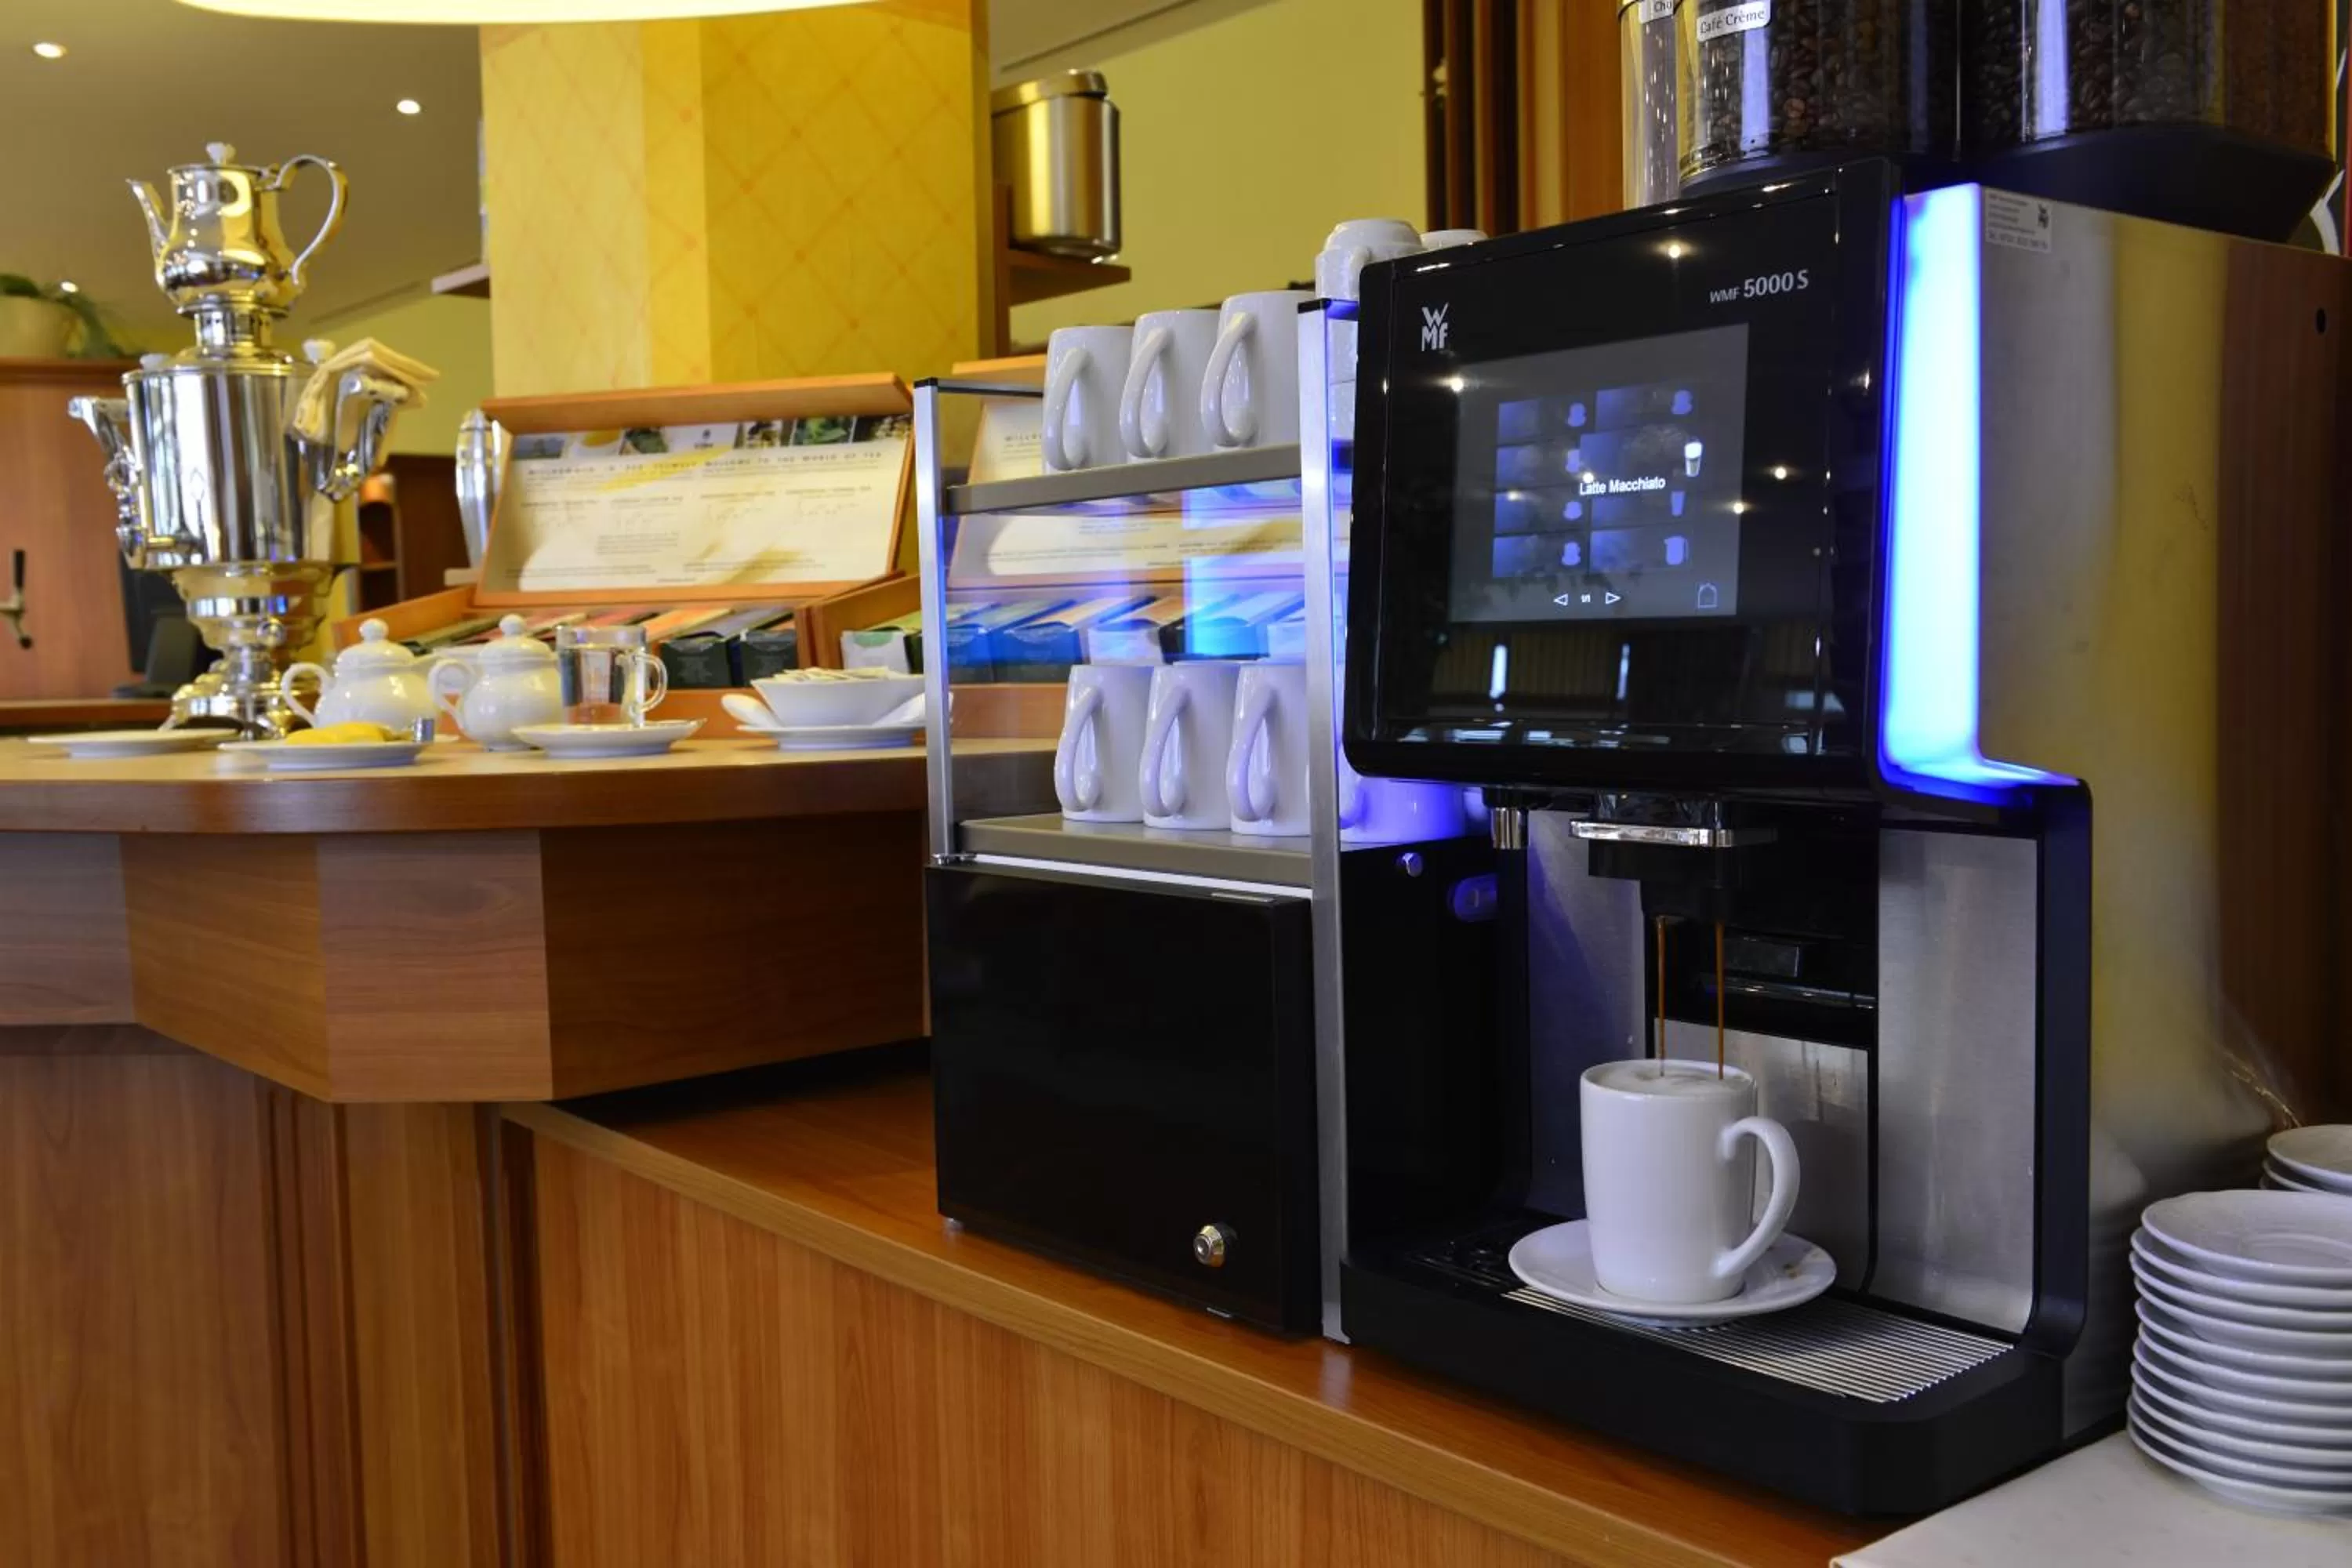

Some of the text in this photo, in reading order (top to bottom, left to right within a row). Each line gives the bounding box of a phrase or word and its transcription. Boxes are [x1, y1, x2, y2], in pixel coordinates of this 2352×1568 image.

[1700, 16, 1723, 34] Café
[1709, 286, 1740, 303] WMF
[1743, 271, 1795, 298] 5000
[1421, 302, 1449, 352] WMF
[1579, 476, 1666, 495] Latte Macchiato
